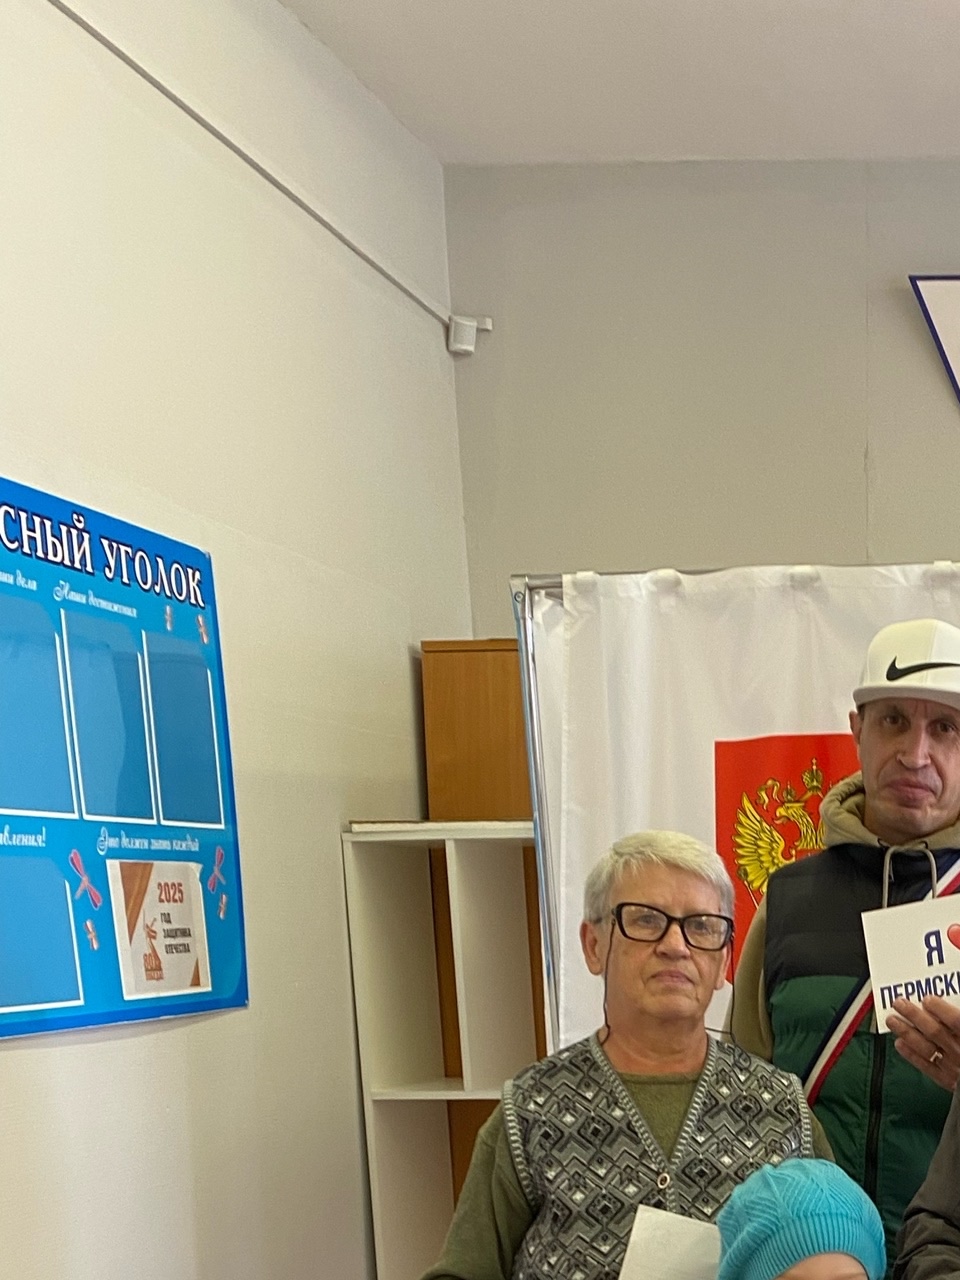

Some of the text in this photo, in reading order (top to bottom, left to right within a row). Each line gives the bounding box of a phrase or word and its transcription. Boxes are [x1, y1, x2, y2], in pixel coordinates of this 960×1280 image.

[100, 537, 205, 608] УГОЛОК
[157, 882, 184, 904] 2025
[924, 929, 945, 967] Я
